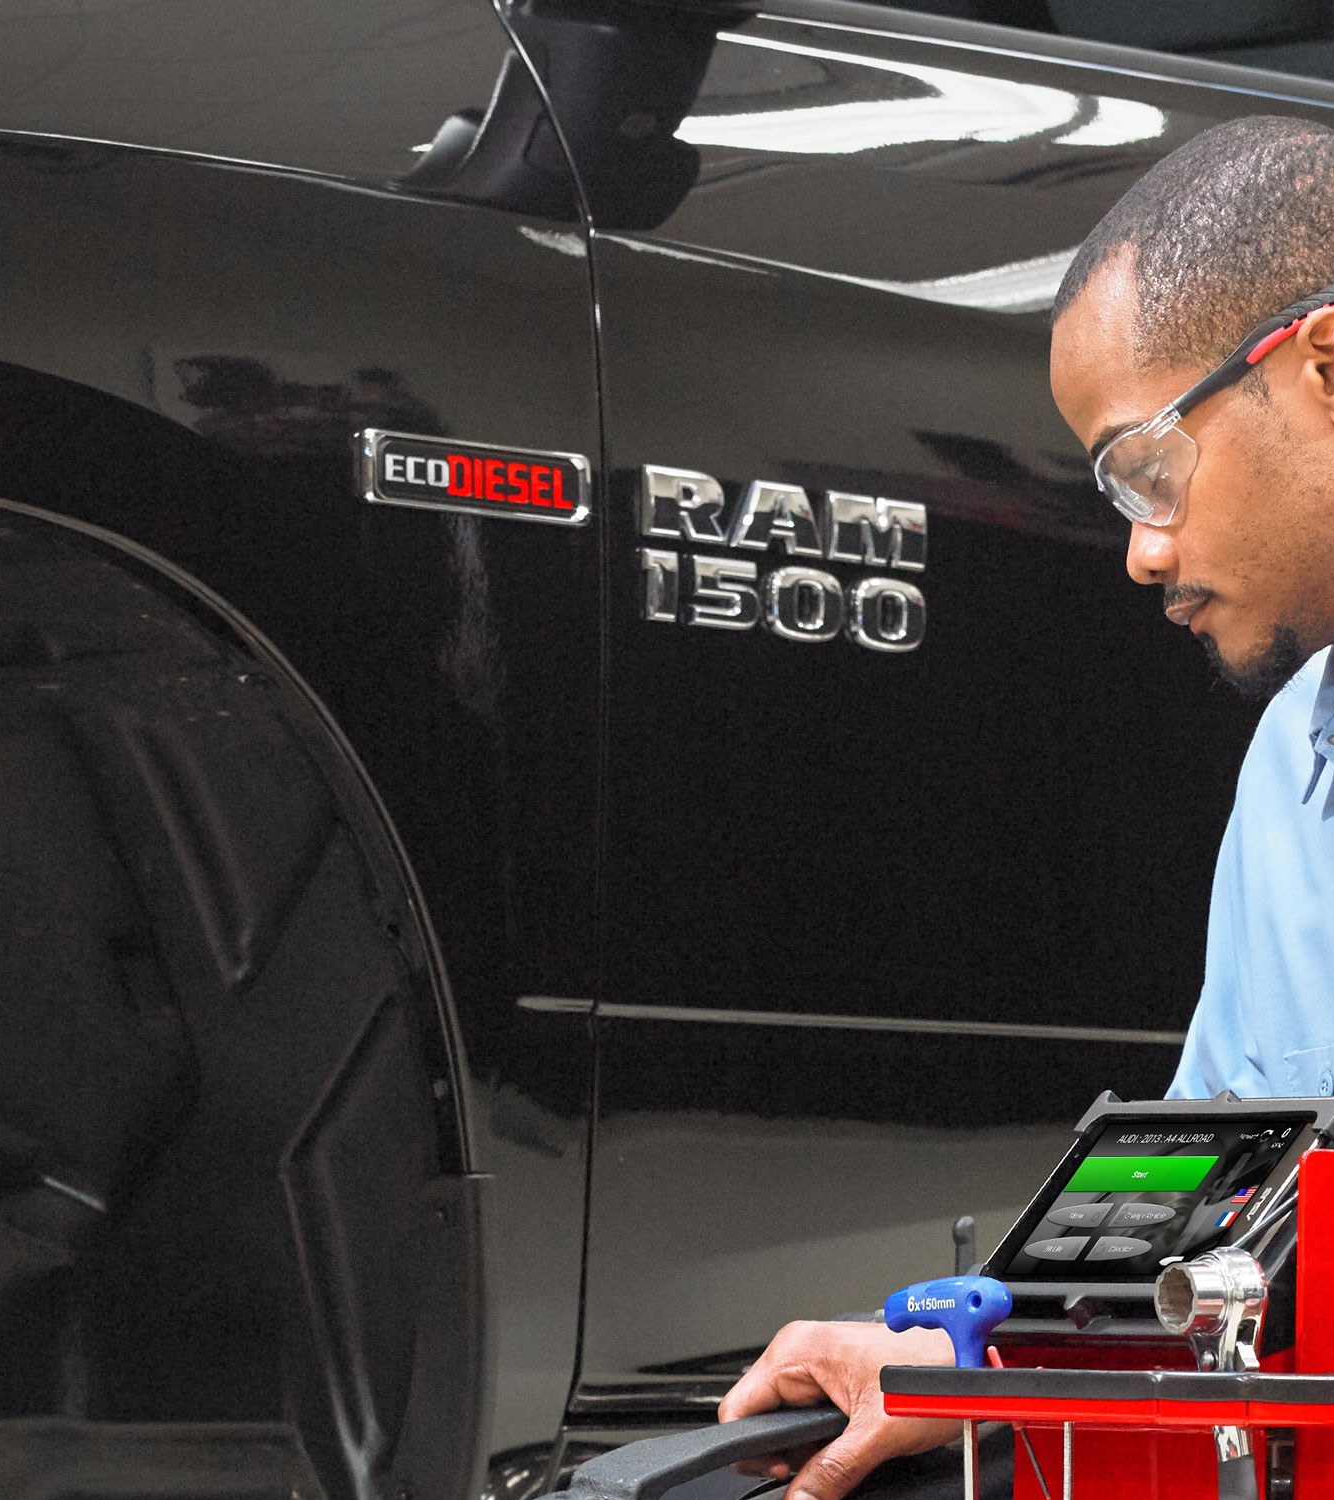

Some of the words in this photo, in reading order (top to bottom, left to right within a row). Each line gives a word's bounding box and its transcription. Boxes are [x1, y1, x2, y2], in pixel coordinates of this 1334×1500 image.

[384, 453, 573, 510] ECODIESEL
[641, 463, 927, 572] RAM
[637, 547, 927, 653] 1500
[1116, 1133, 1140, 1144] AUDI
[1140, 1133, 1163, 1144] 2013
[1175, 1133, 1215, 1144] ALLROAD
[1131, 1171, 1149, 1179] Start
[907, 1296, 955, 1313] 6x150mm
